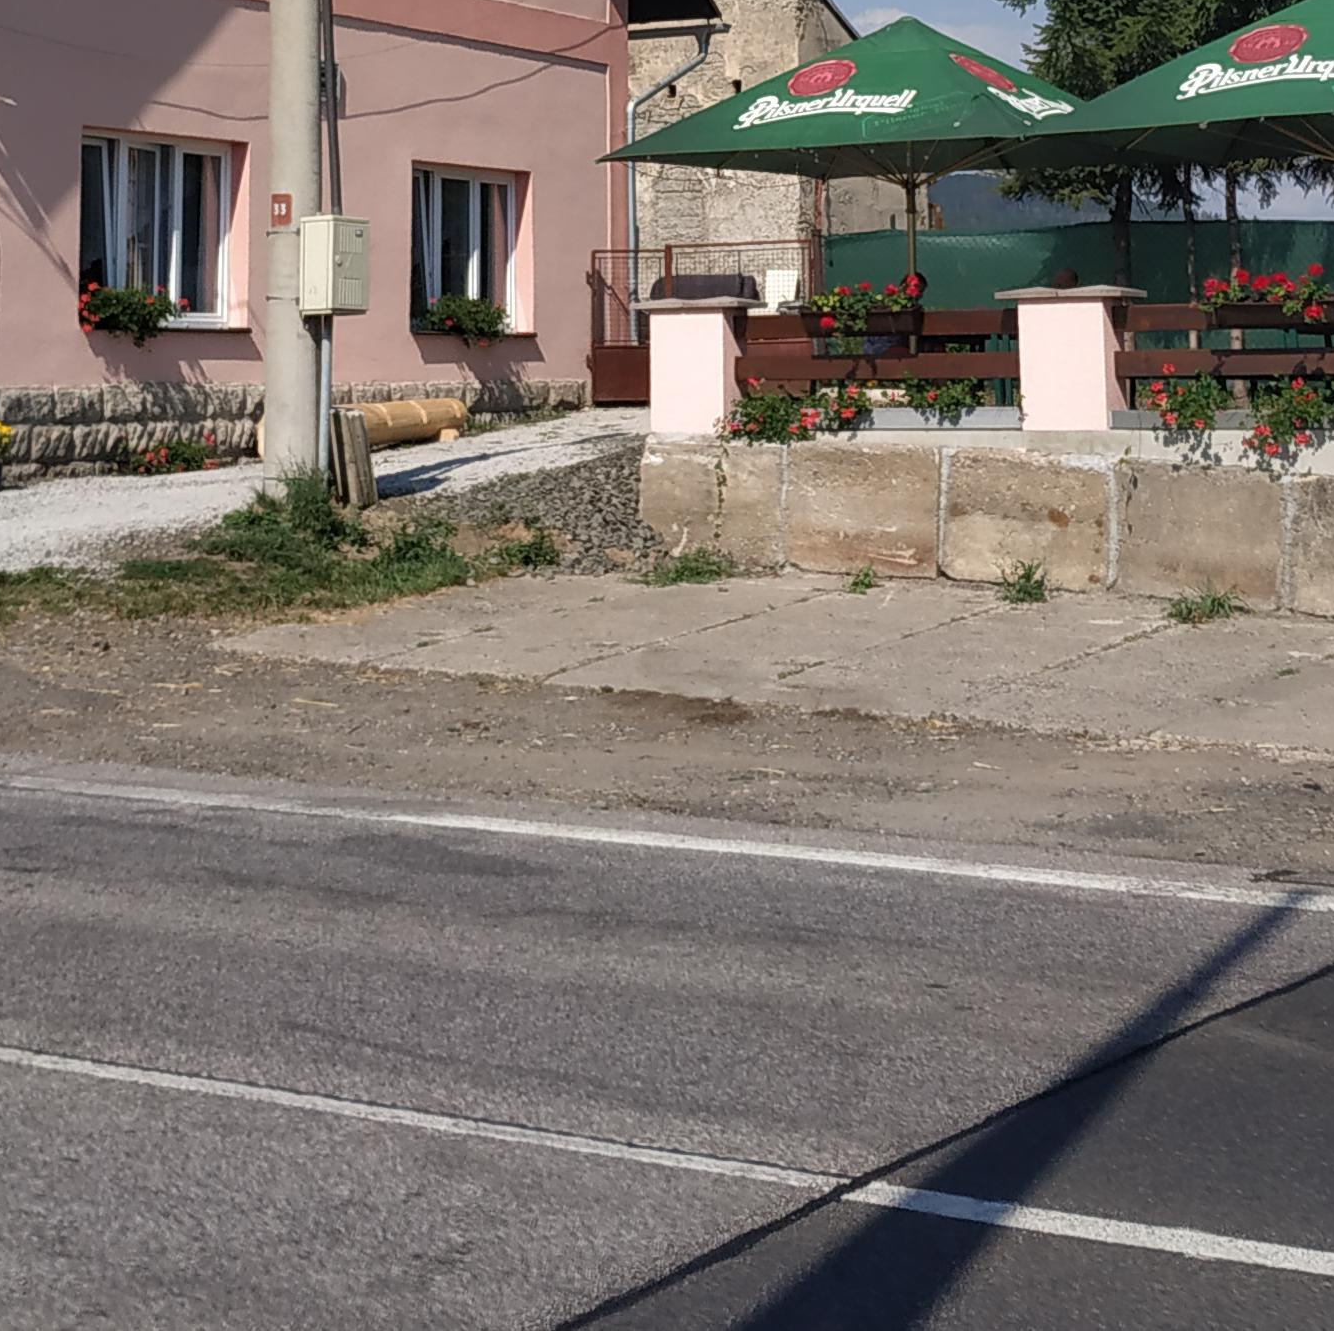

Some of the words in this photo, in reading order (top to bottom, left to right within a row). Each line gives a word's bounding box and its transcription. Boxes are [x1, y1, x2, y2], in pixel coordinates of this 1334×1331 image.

[1176, 62, 1289, 100] Pilsner
[733, 95, 832, 130] Pilsner
[829, 88, 917, 115] Urquell
[273, 202, 287, 216] 33
